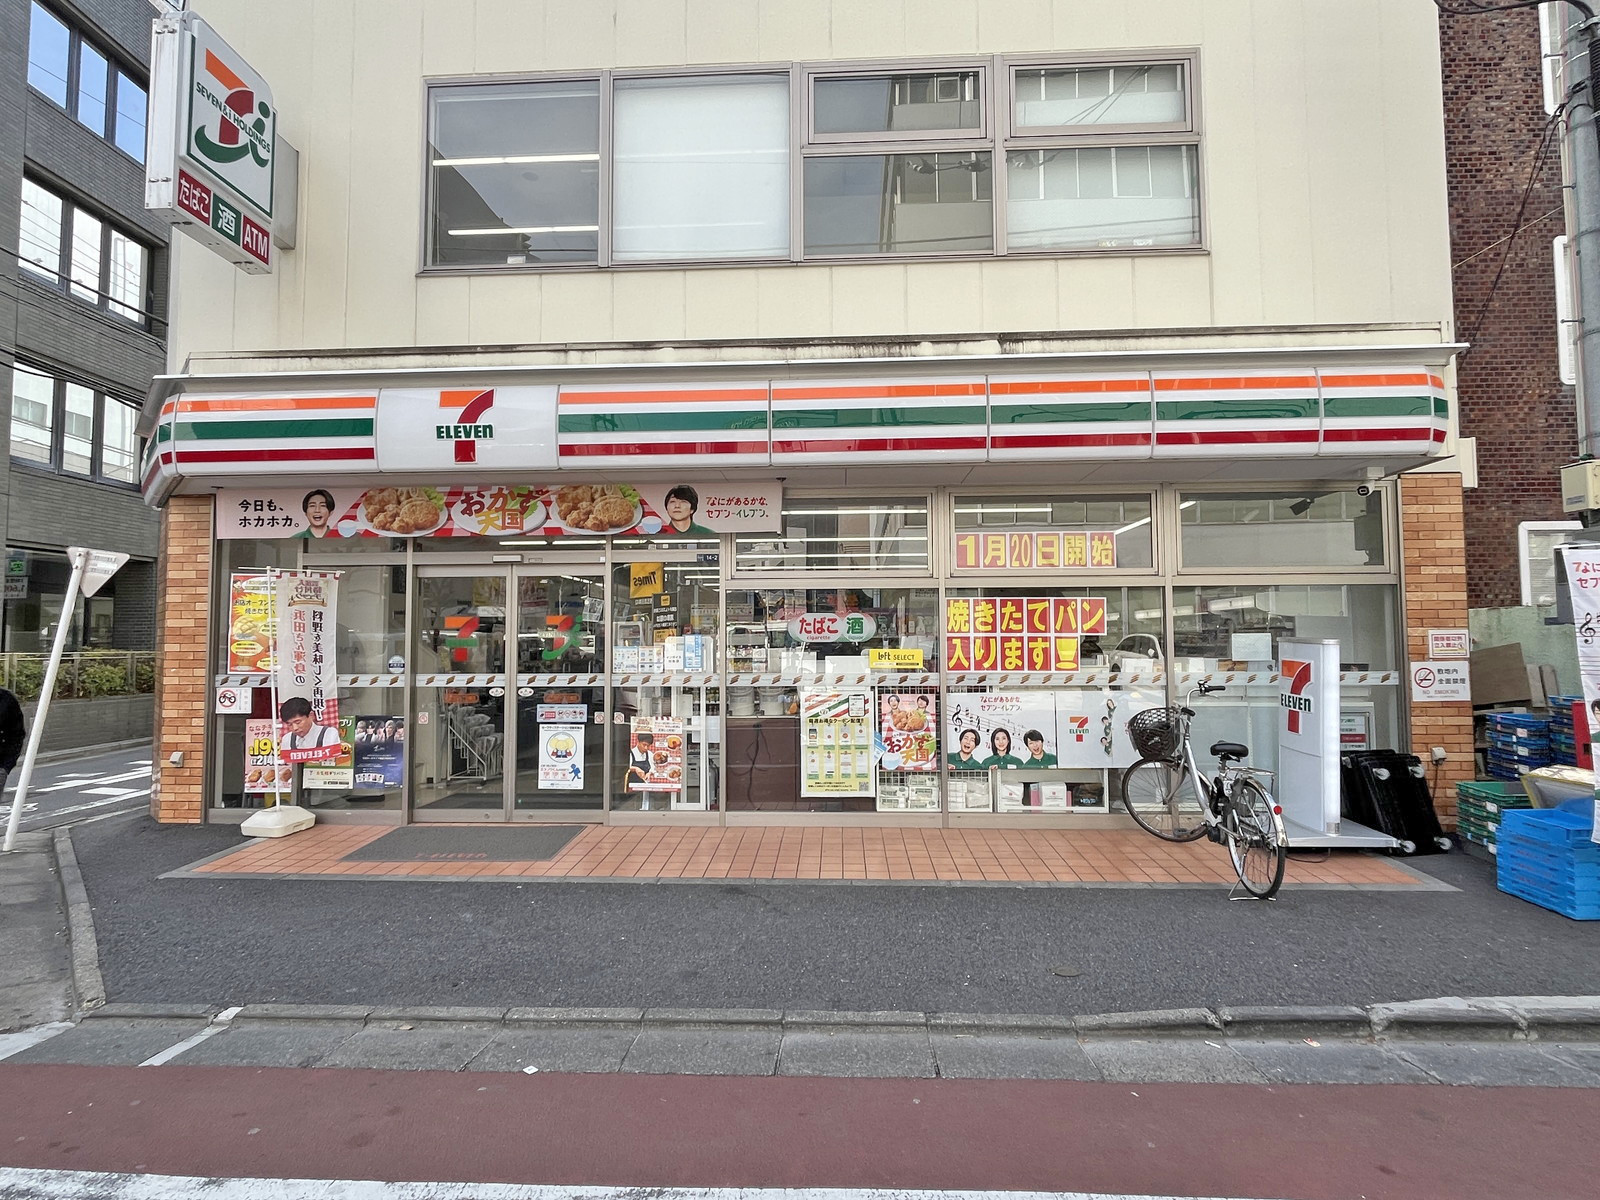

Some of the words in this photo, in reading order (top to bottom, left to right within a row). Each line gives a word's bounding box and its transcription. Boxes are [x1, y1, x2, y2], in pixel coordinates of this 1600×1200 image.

[233, 115, 271, 154] HOLDINGS
[179, 177, 210, 218] たばこ
[217, 202, 237, 237] 酒
[243, 226, 268, 259] ATM
[238, 499, 284, 513] 今日も、
[460, 486, 550, 517] おかず
[238, 515, 300, 529] ホカホカ。
[475, 508, 525, 536] 天国
[958, 534, 1113, 567] 1月20日開始
[799, 616, 839, 635] たばこ
[846, 616, 864, 635] 酒
[947, 600, 1104, 633] 焼きたてパン
[1437, 677, 1467, 685] 全面禁煙
[900, 748, 929, 766] 天国
